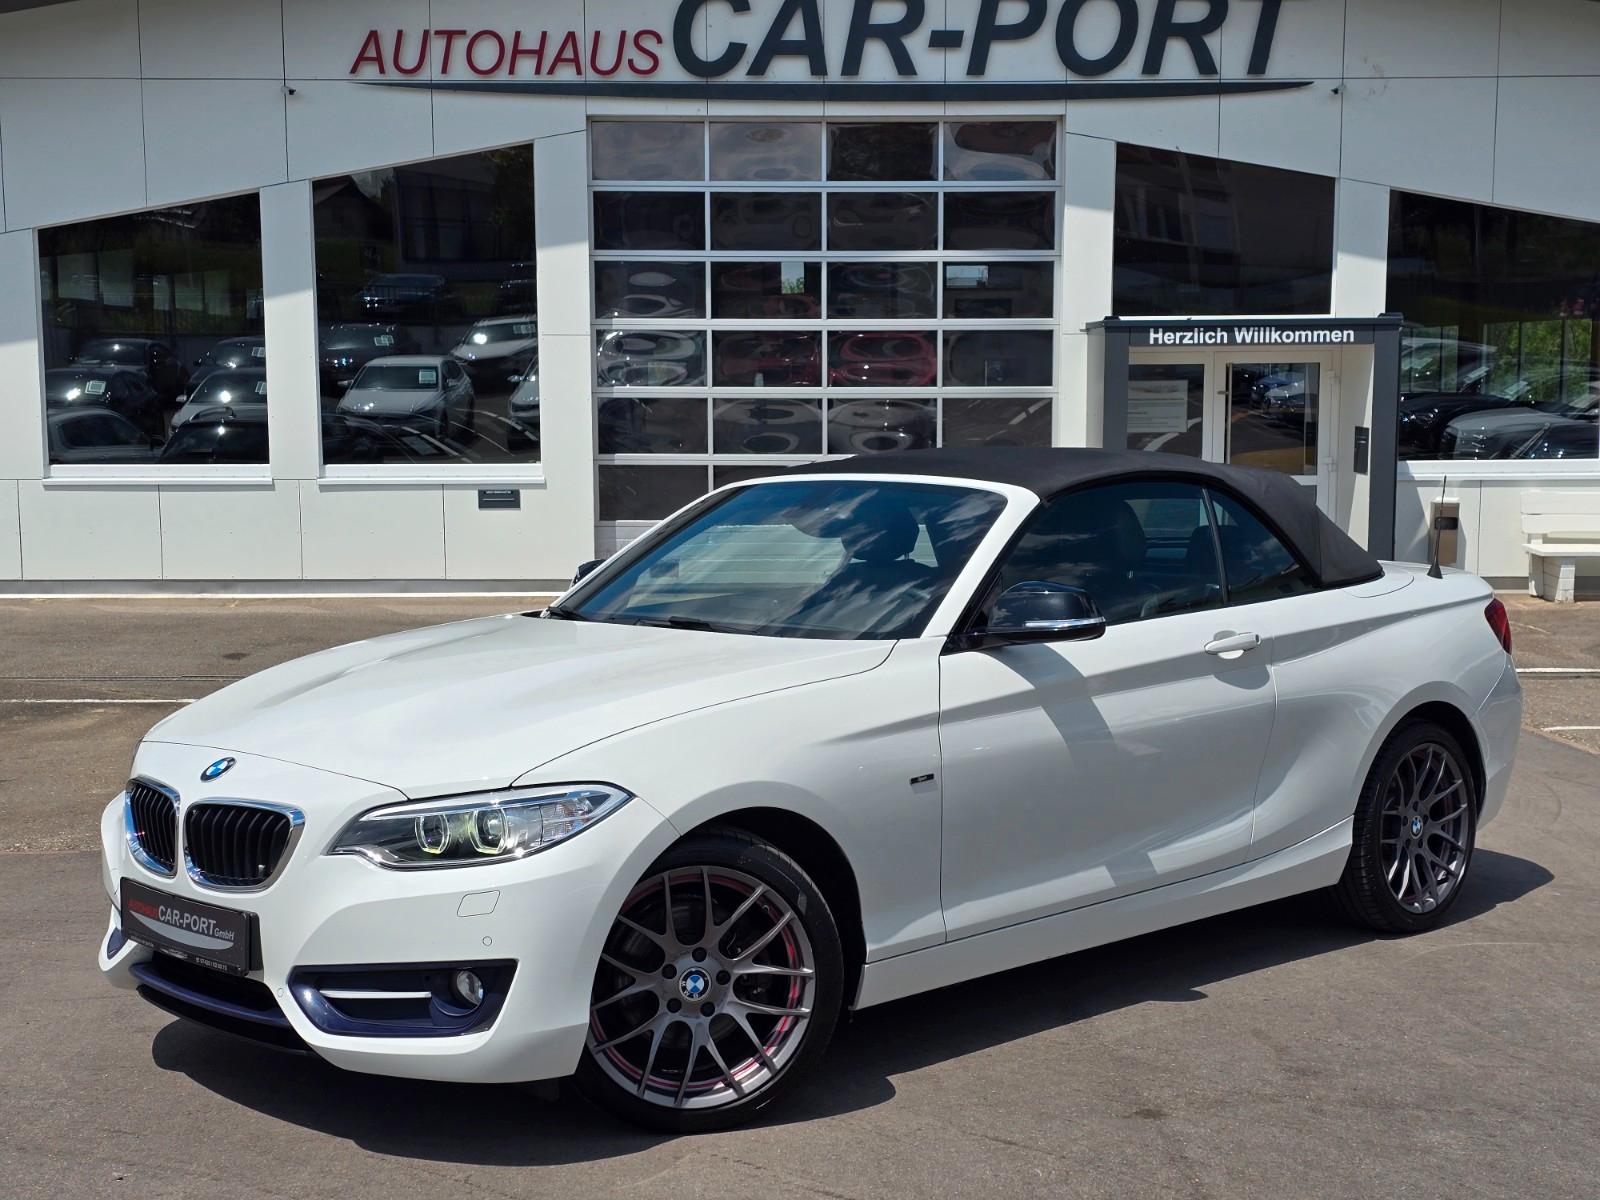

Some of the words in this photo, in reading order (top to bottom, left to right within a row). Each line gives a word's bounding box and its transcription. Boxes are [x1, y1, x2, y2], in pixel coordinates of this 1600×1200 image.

[349, 29, 662, 76] AUTOHAUS
[1149, 327, 1228, 345] Herzlich
[1234, 327, 1355, 344] Willkommen
[158, 905, 217, 936] CAR-PORT
[214, 927, 235, 941] GmbH
